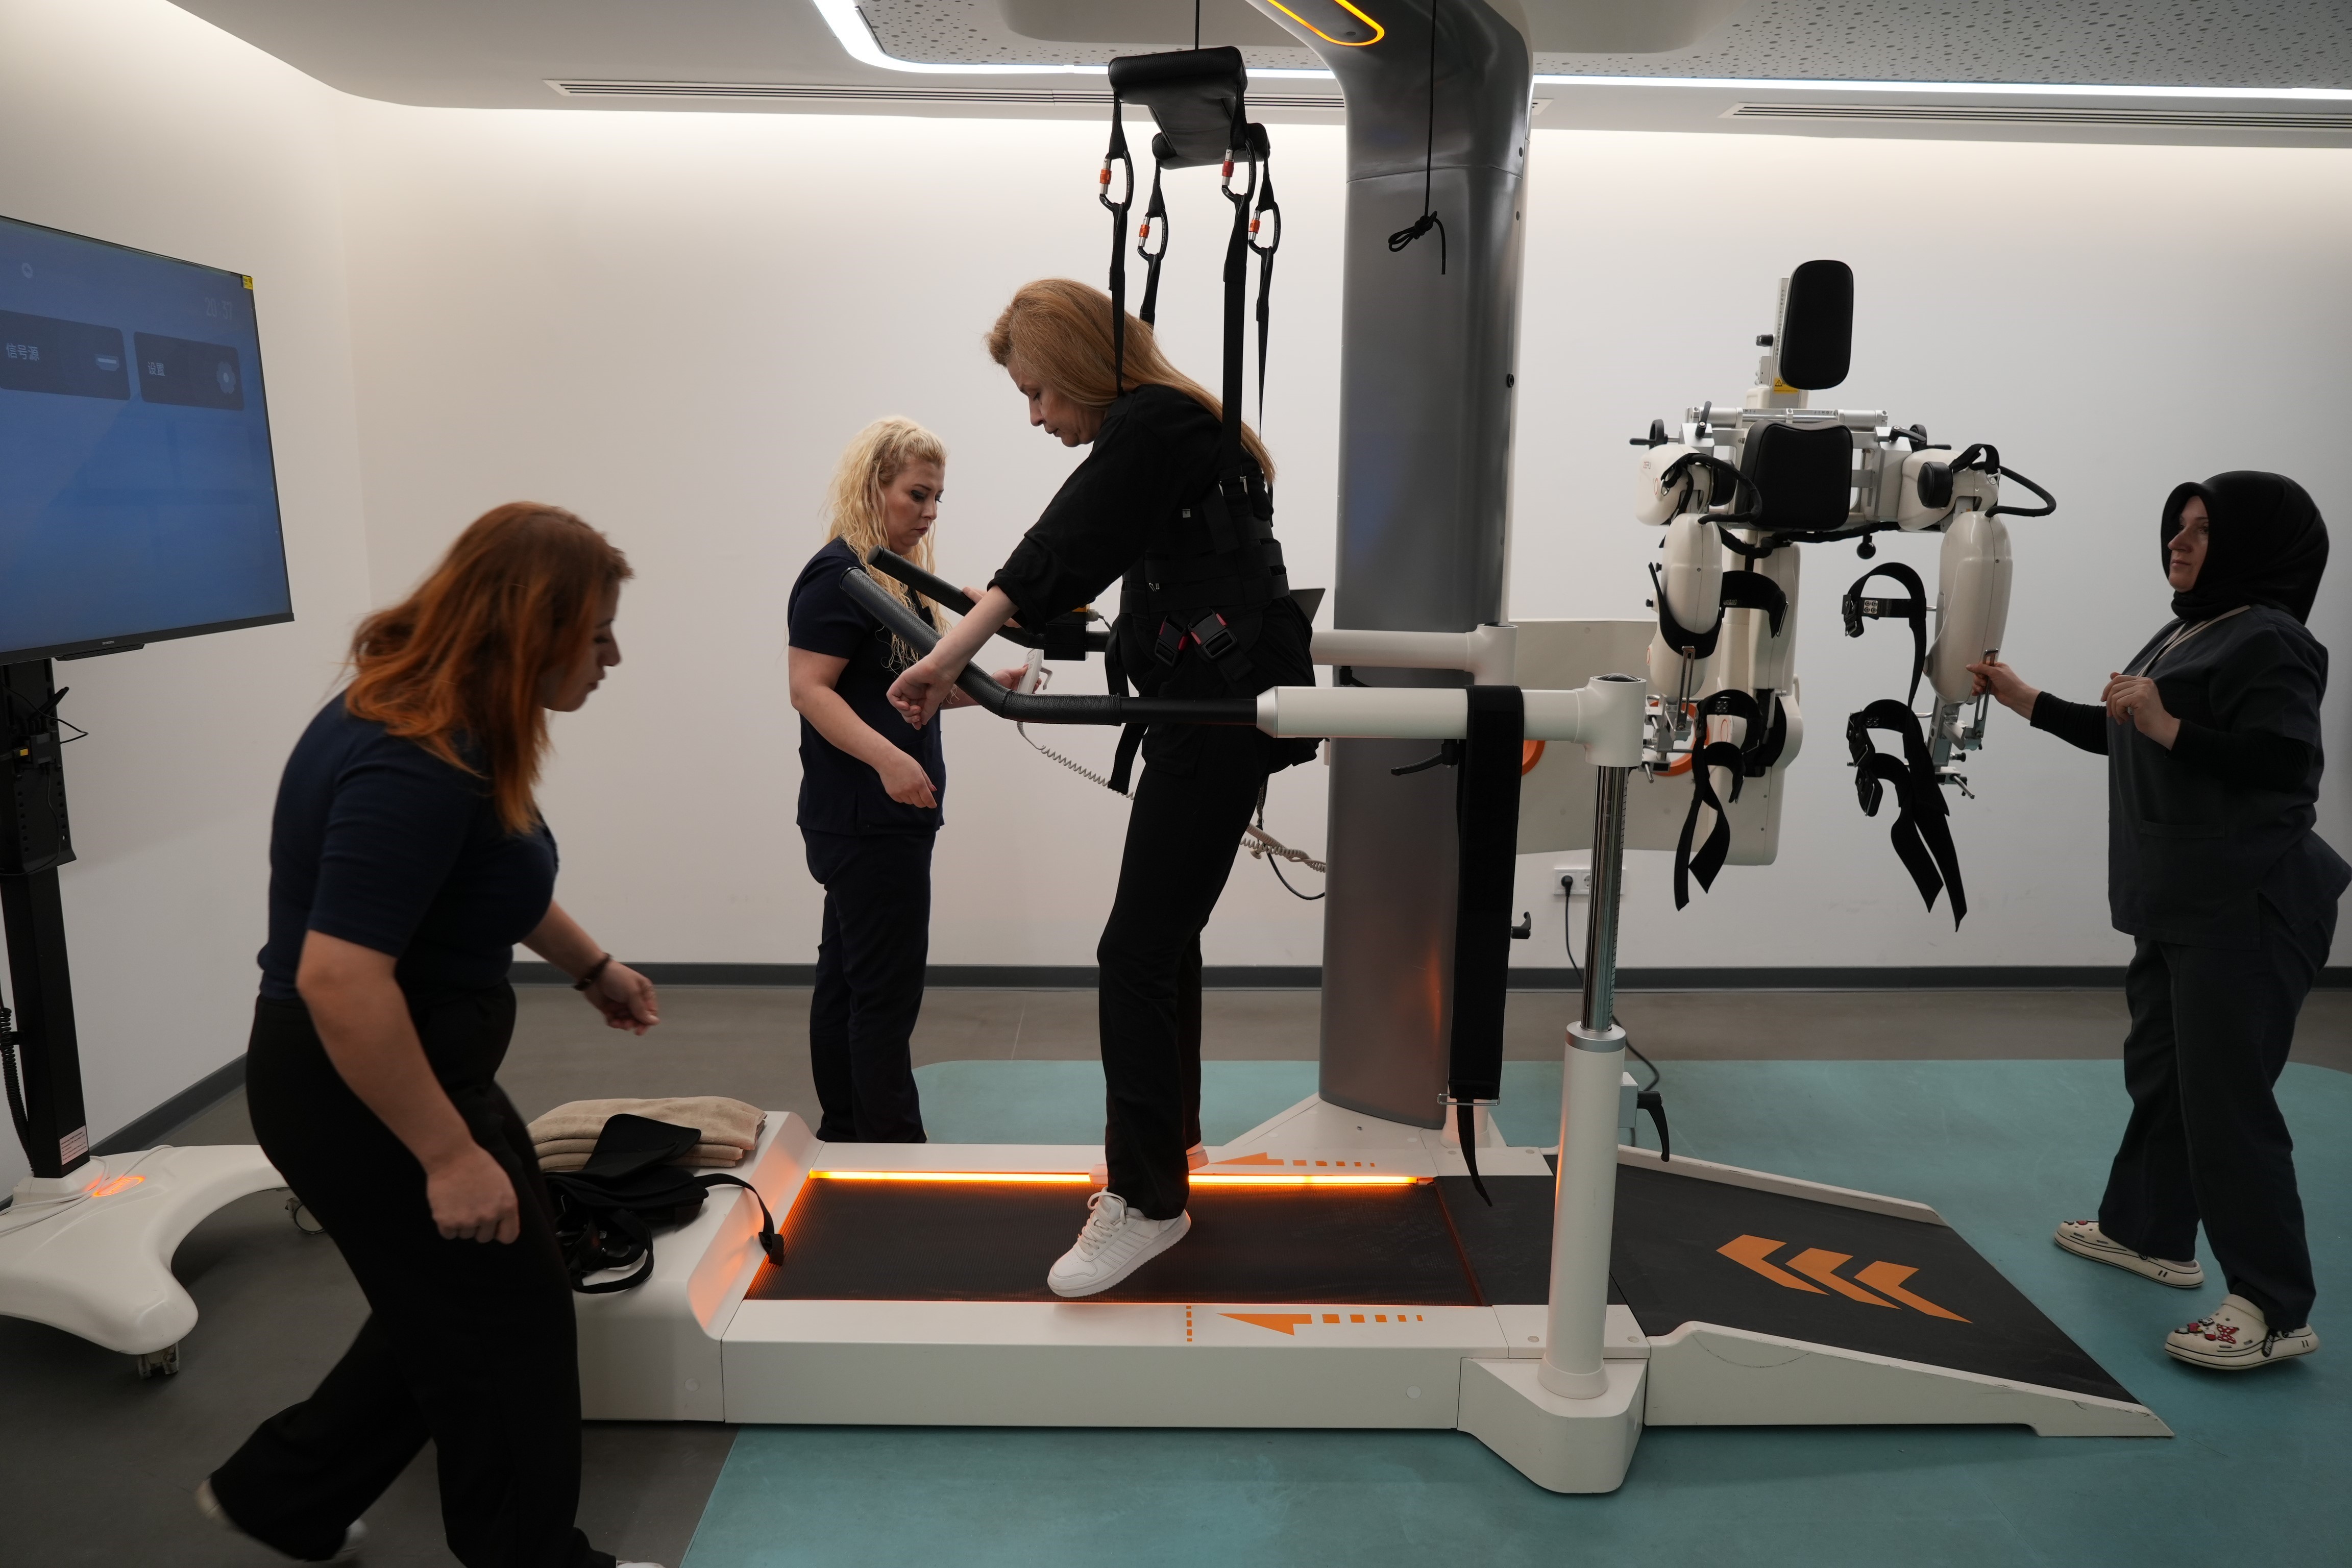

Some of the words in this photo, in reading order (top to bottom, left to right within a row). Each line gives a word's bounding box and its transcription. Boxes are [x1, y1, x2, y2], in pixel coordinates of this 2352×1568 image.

[204, 297, 232, 321] 20:37
[6, 342, 40, 361] 信号源
[146, 361, 165, 376] 设置
